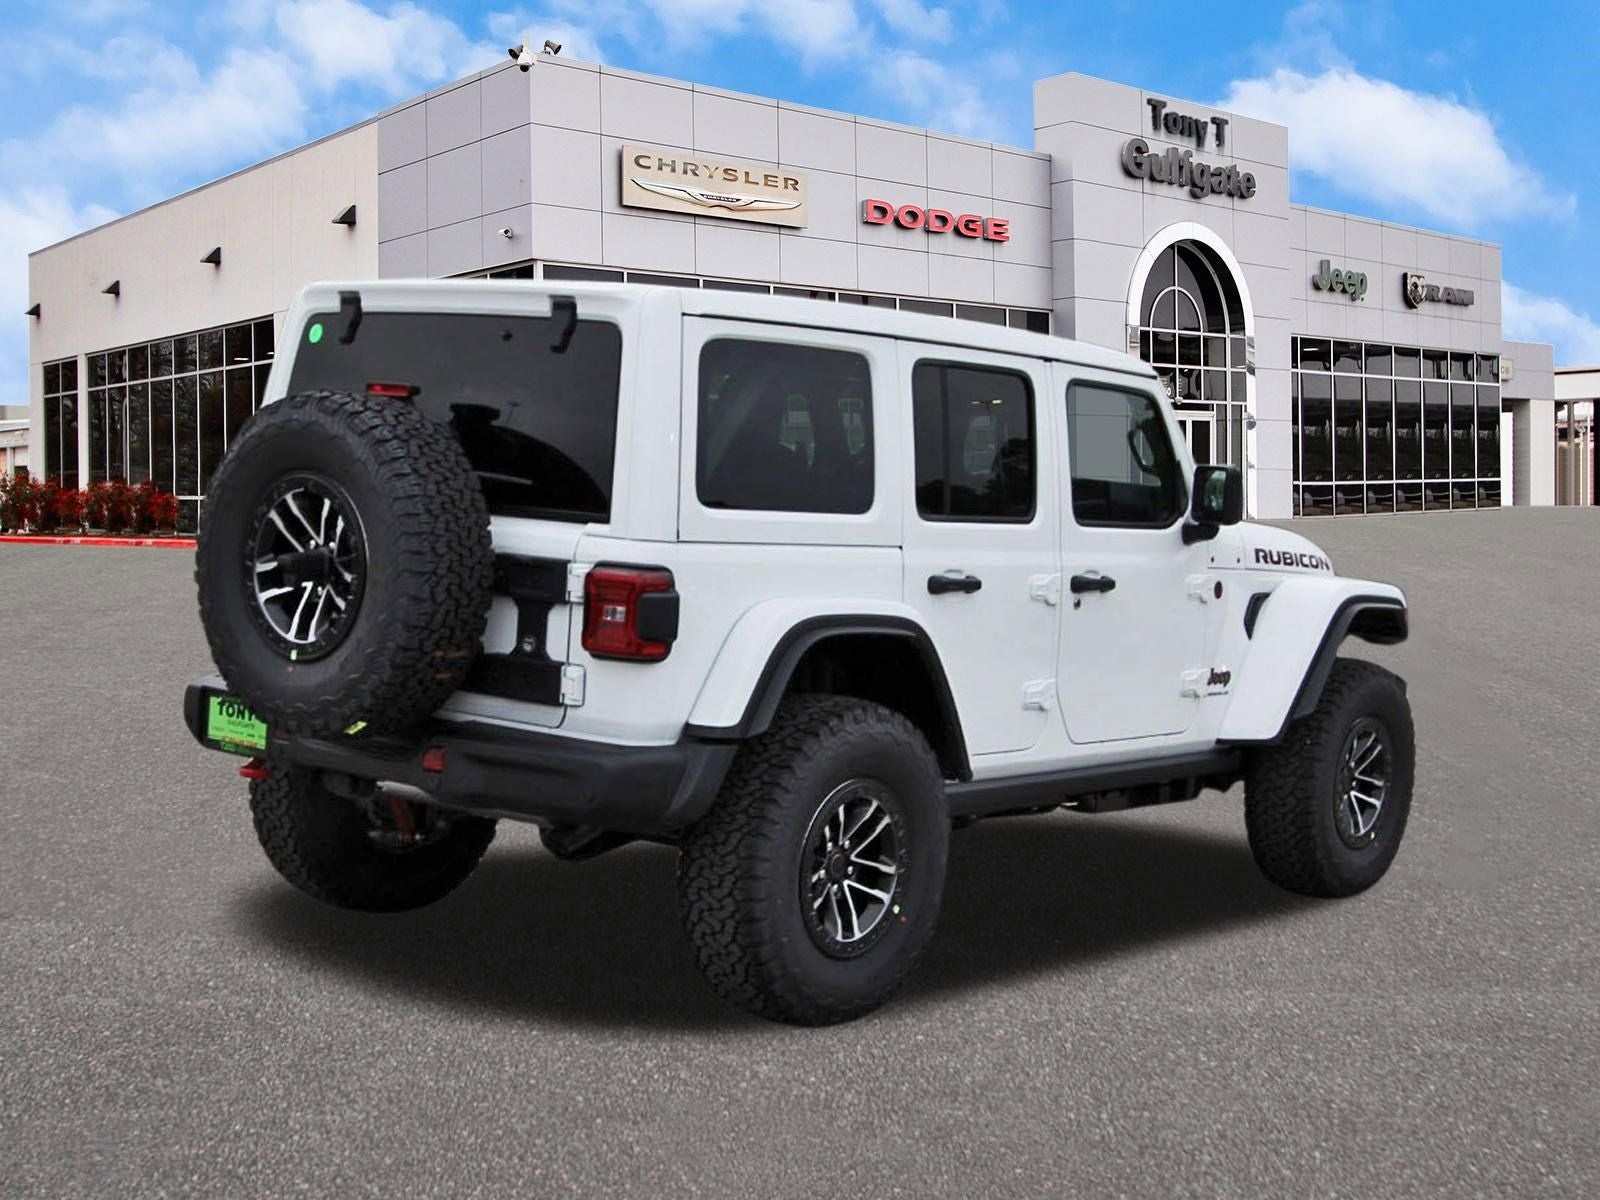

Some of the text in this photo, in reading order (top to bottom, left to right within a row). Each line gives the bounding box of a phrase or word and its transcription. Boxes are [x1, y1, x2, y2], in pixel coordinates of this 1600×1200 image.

[1146, 98, 1229, 148] Tony T
[634, 154, 800, 192] CHRYSLER
[1121, 138, 1256, 199] Gulfgate
[862, 199, 1011, 243] DODGE
[1312, 259, 1368, 302] Jeep
[1424, 284, 1475, 307] RAM
[1254, 548, 1331, 571] RUBICON
[1207, 667, 1231, 687] Jeep
